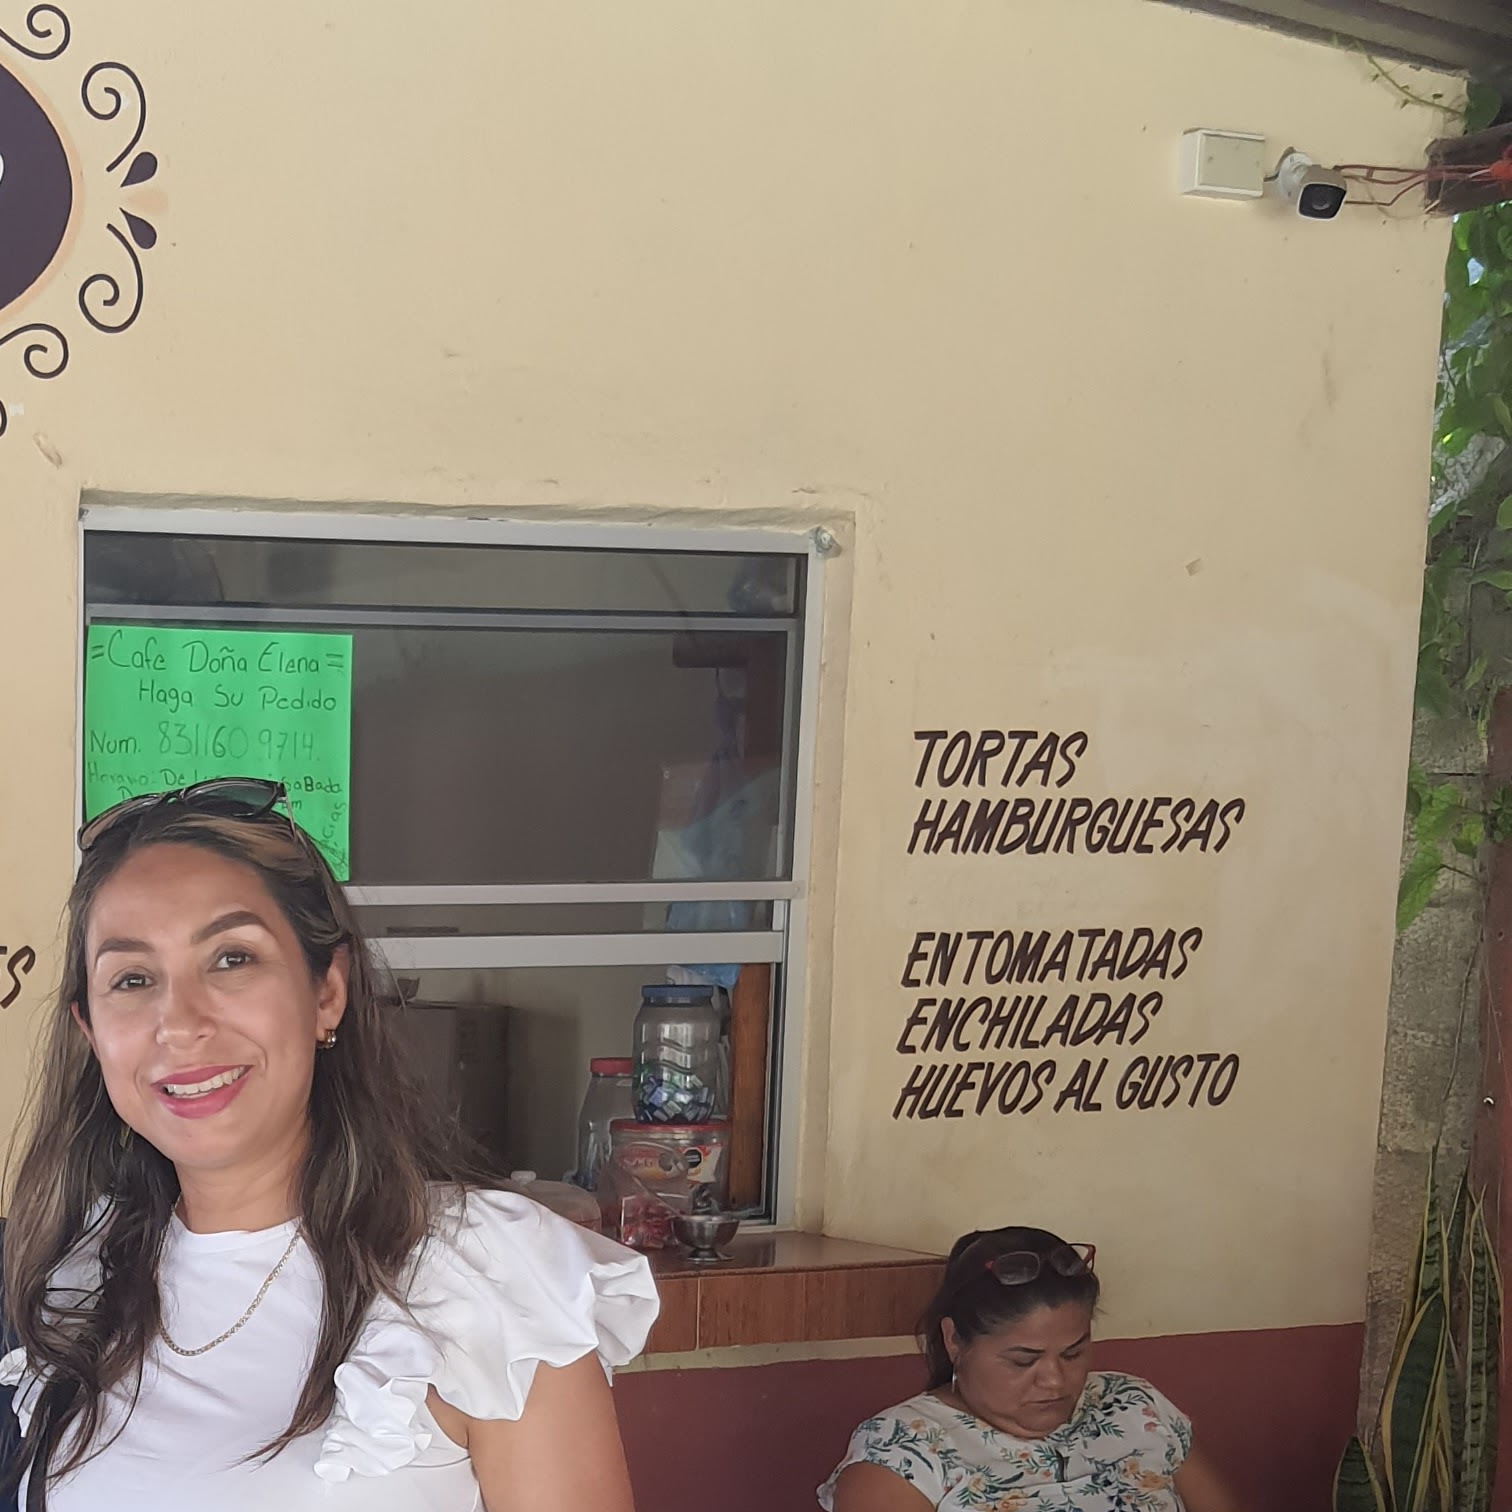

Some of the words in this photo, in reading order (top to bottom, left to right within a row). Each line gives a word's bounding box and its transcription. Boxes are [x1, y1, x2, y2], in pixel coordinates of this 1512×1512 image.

[182, 640, 248, 674] Doña
[138, 679, 194, 714] Haga
[214, 684, 244, 708] Su
[258, 686, 338, 711] Pedido
[913, 729, 1089, 789] TORTAS
[905, 796, 1246, 856] HAMBURGUESAS
[899, 926, 1204, 988] ENTOMATADAS
[895, 990, 1164, 1055] ENCHILADAS
[892, 1058, 1057, 1121] HUEVOS
[1053, 1056, 1110, 1113] AL
[1116, 1052, 1241, 1111] GUSTO
